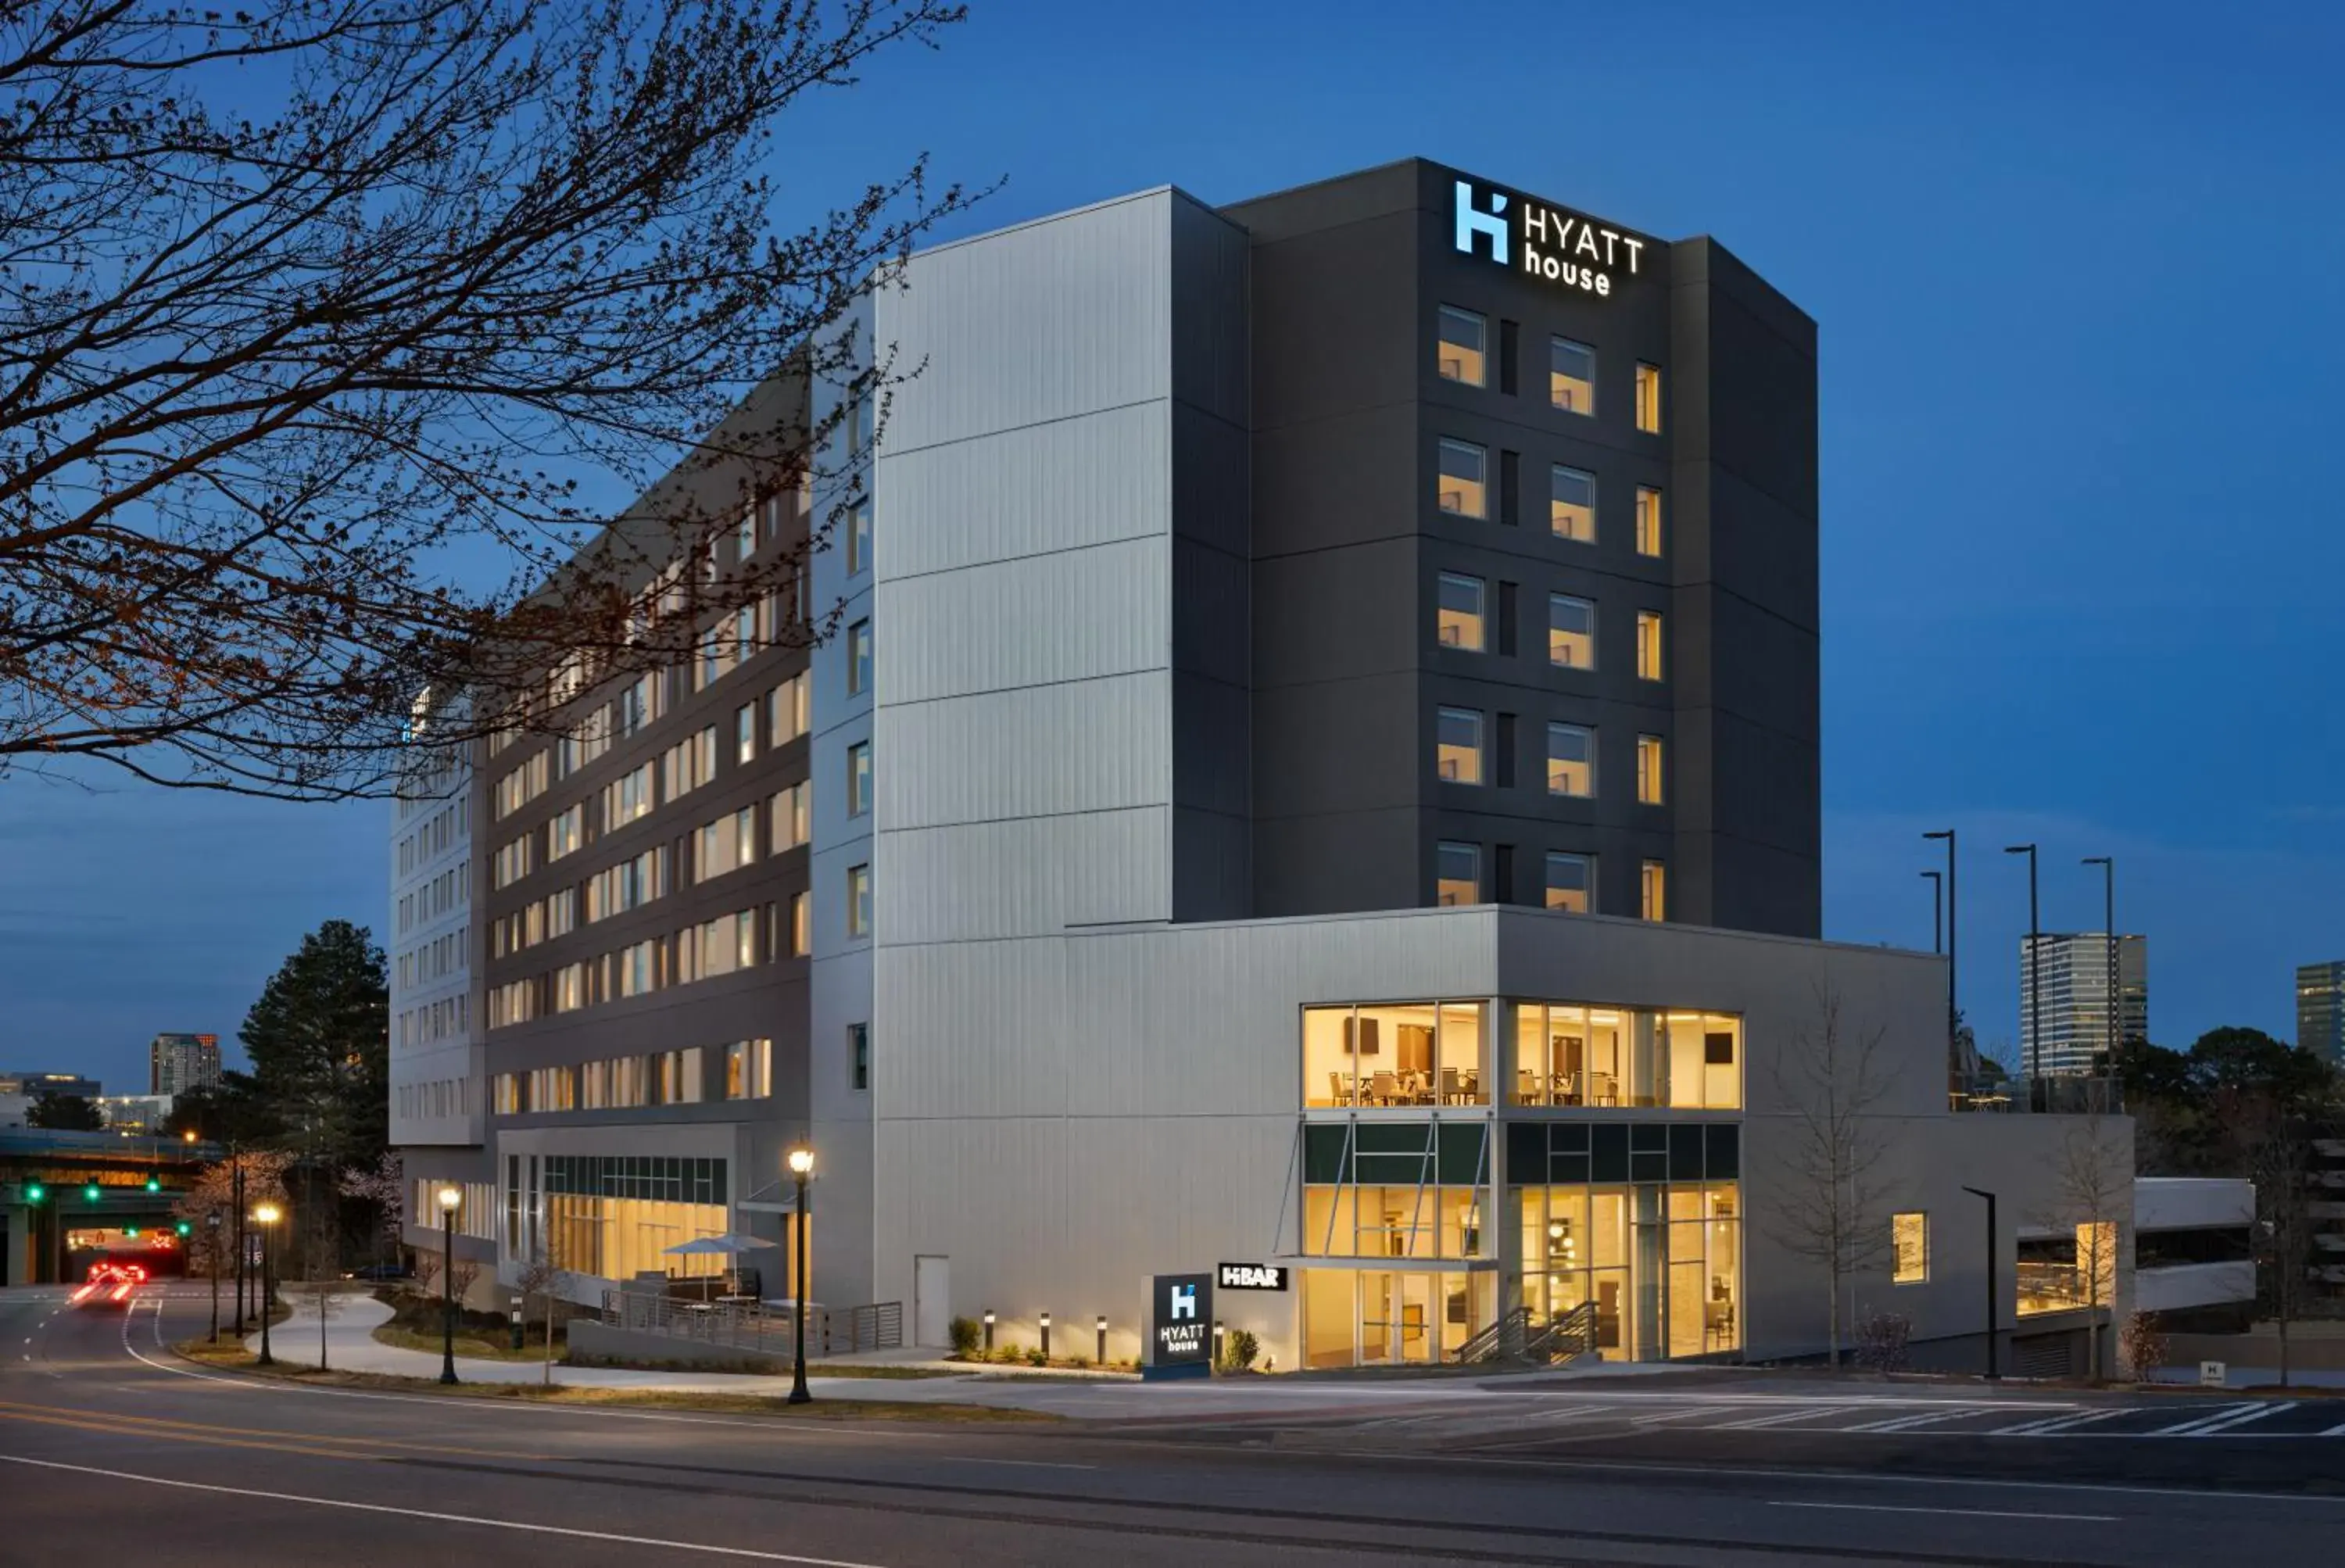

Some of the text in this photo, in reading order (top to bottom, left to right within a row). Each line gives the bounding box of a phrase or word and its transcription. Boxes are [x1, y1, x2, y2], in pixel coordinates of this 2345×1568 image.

[1524, 203, 1644, 274] HYATT
[1524, 242, 1611, 296] house
[1161, 1323, 1205, 1342] HYATT
[1168, 1340, 1198, 1352] house
